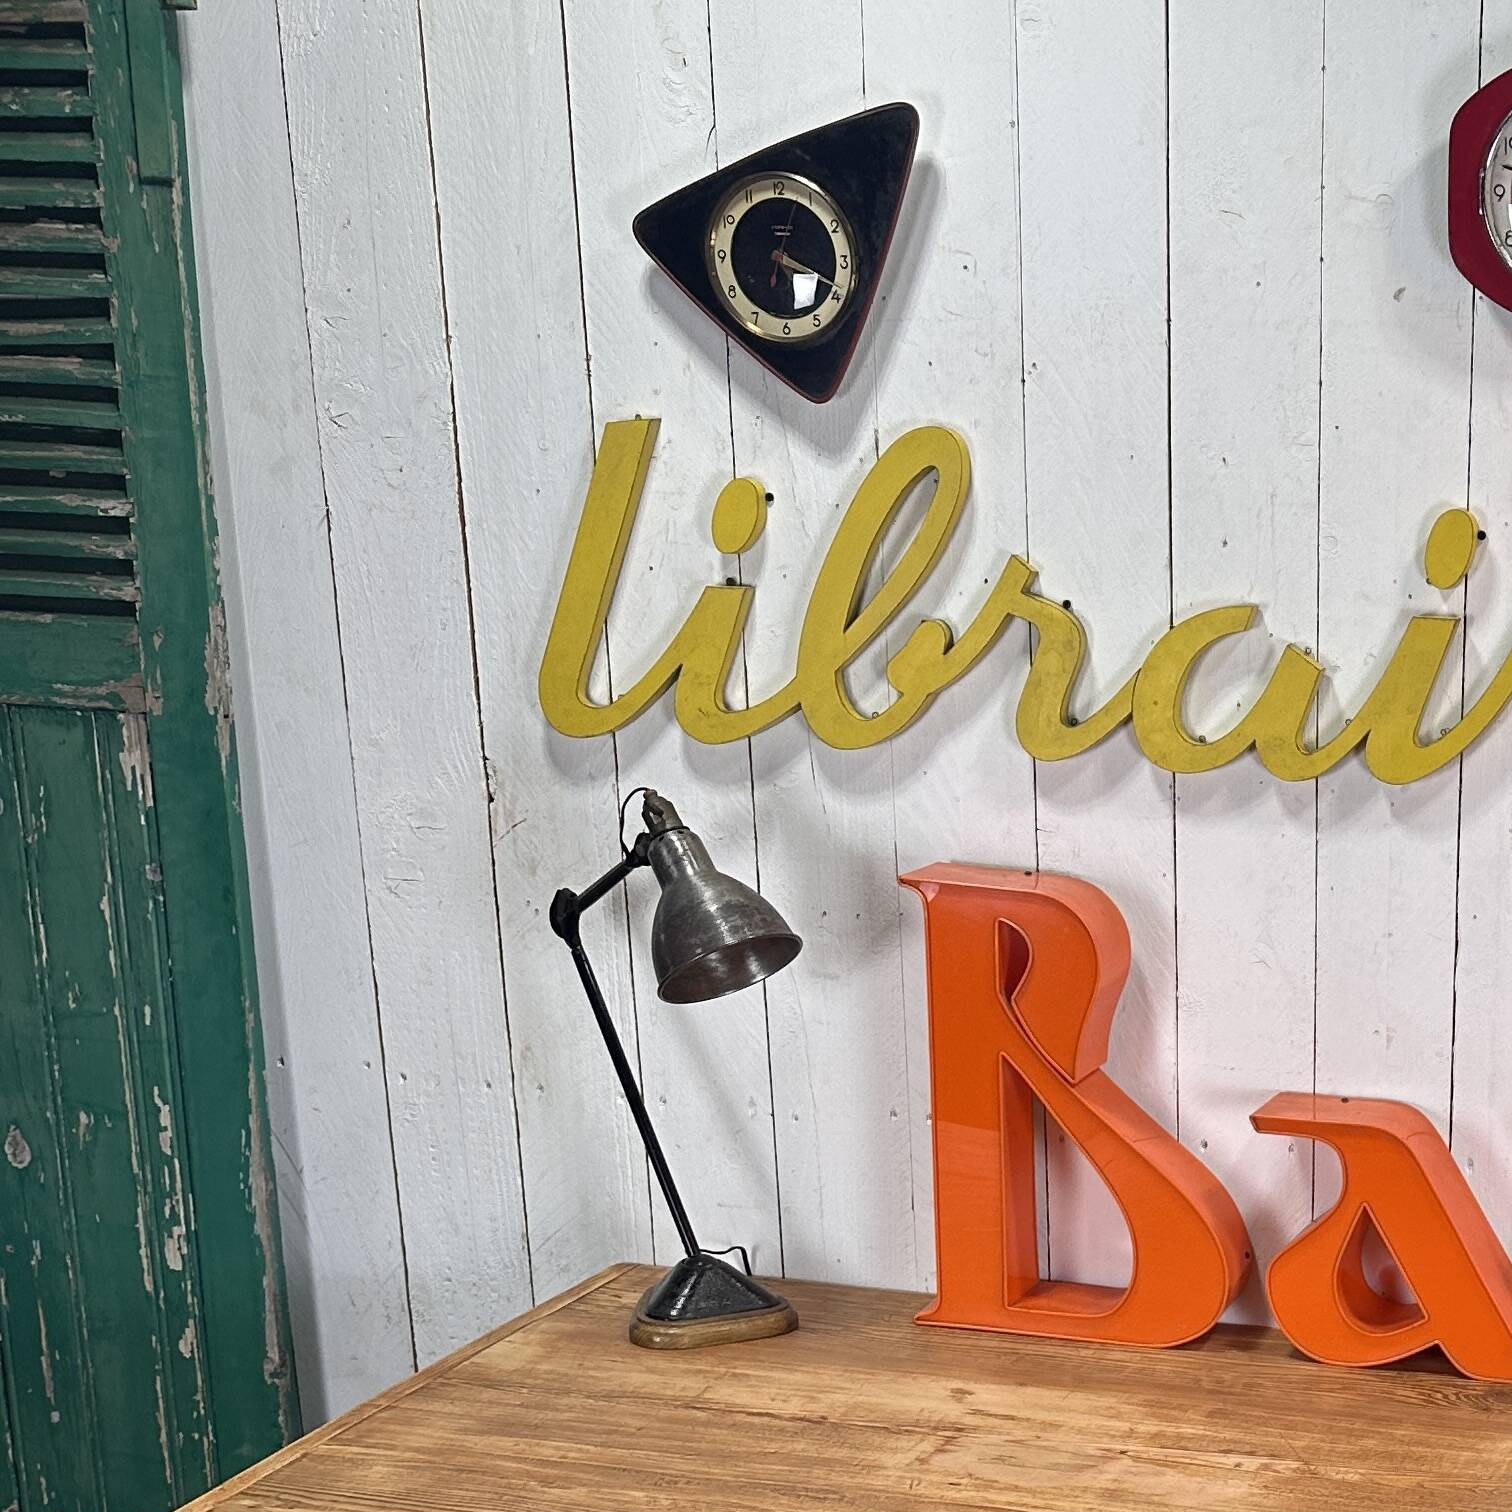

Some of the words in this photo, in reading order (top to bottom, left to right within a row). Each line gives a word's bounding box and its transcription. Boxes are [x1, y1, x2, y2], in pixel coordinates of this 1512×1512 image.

[773, 181, 785, 195] 12
[1494, 184, 1506, 202] 9
[722, 214, 735, 228] 10
[830, 220, 840, 233] 2
[717, 249, 727, 263] 9
[839, 255, 848, 269] 3
[727, 285, 737, 299] 8
[751, 312, 760, 325] 7
[813, 314, 821, 328] 5
[782, 321, 791, 335] 6
